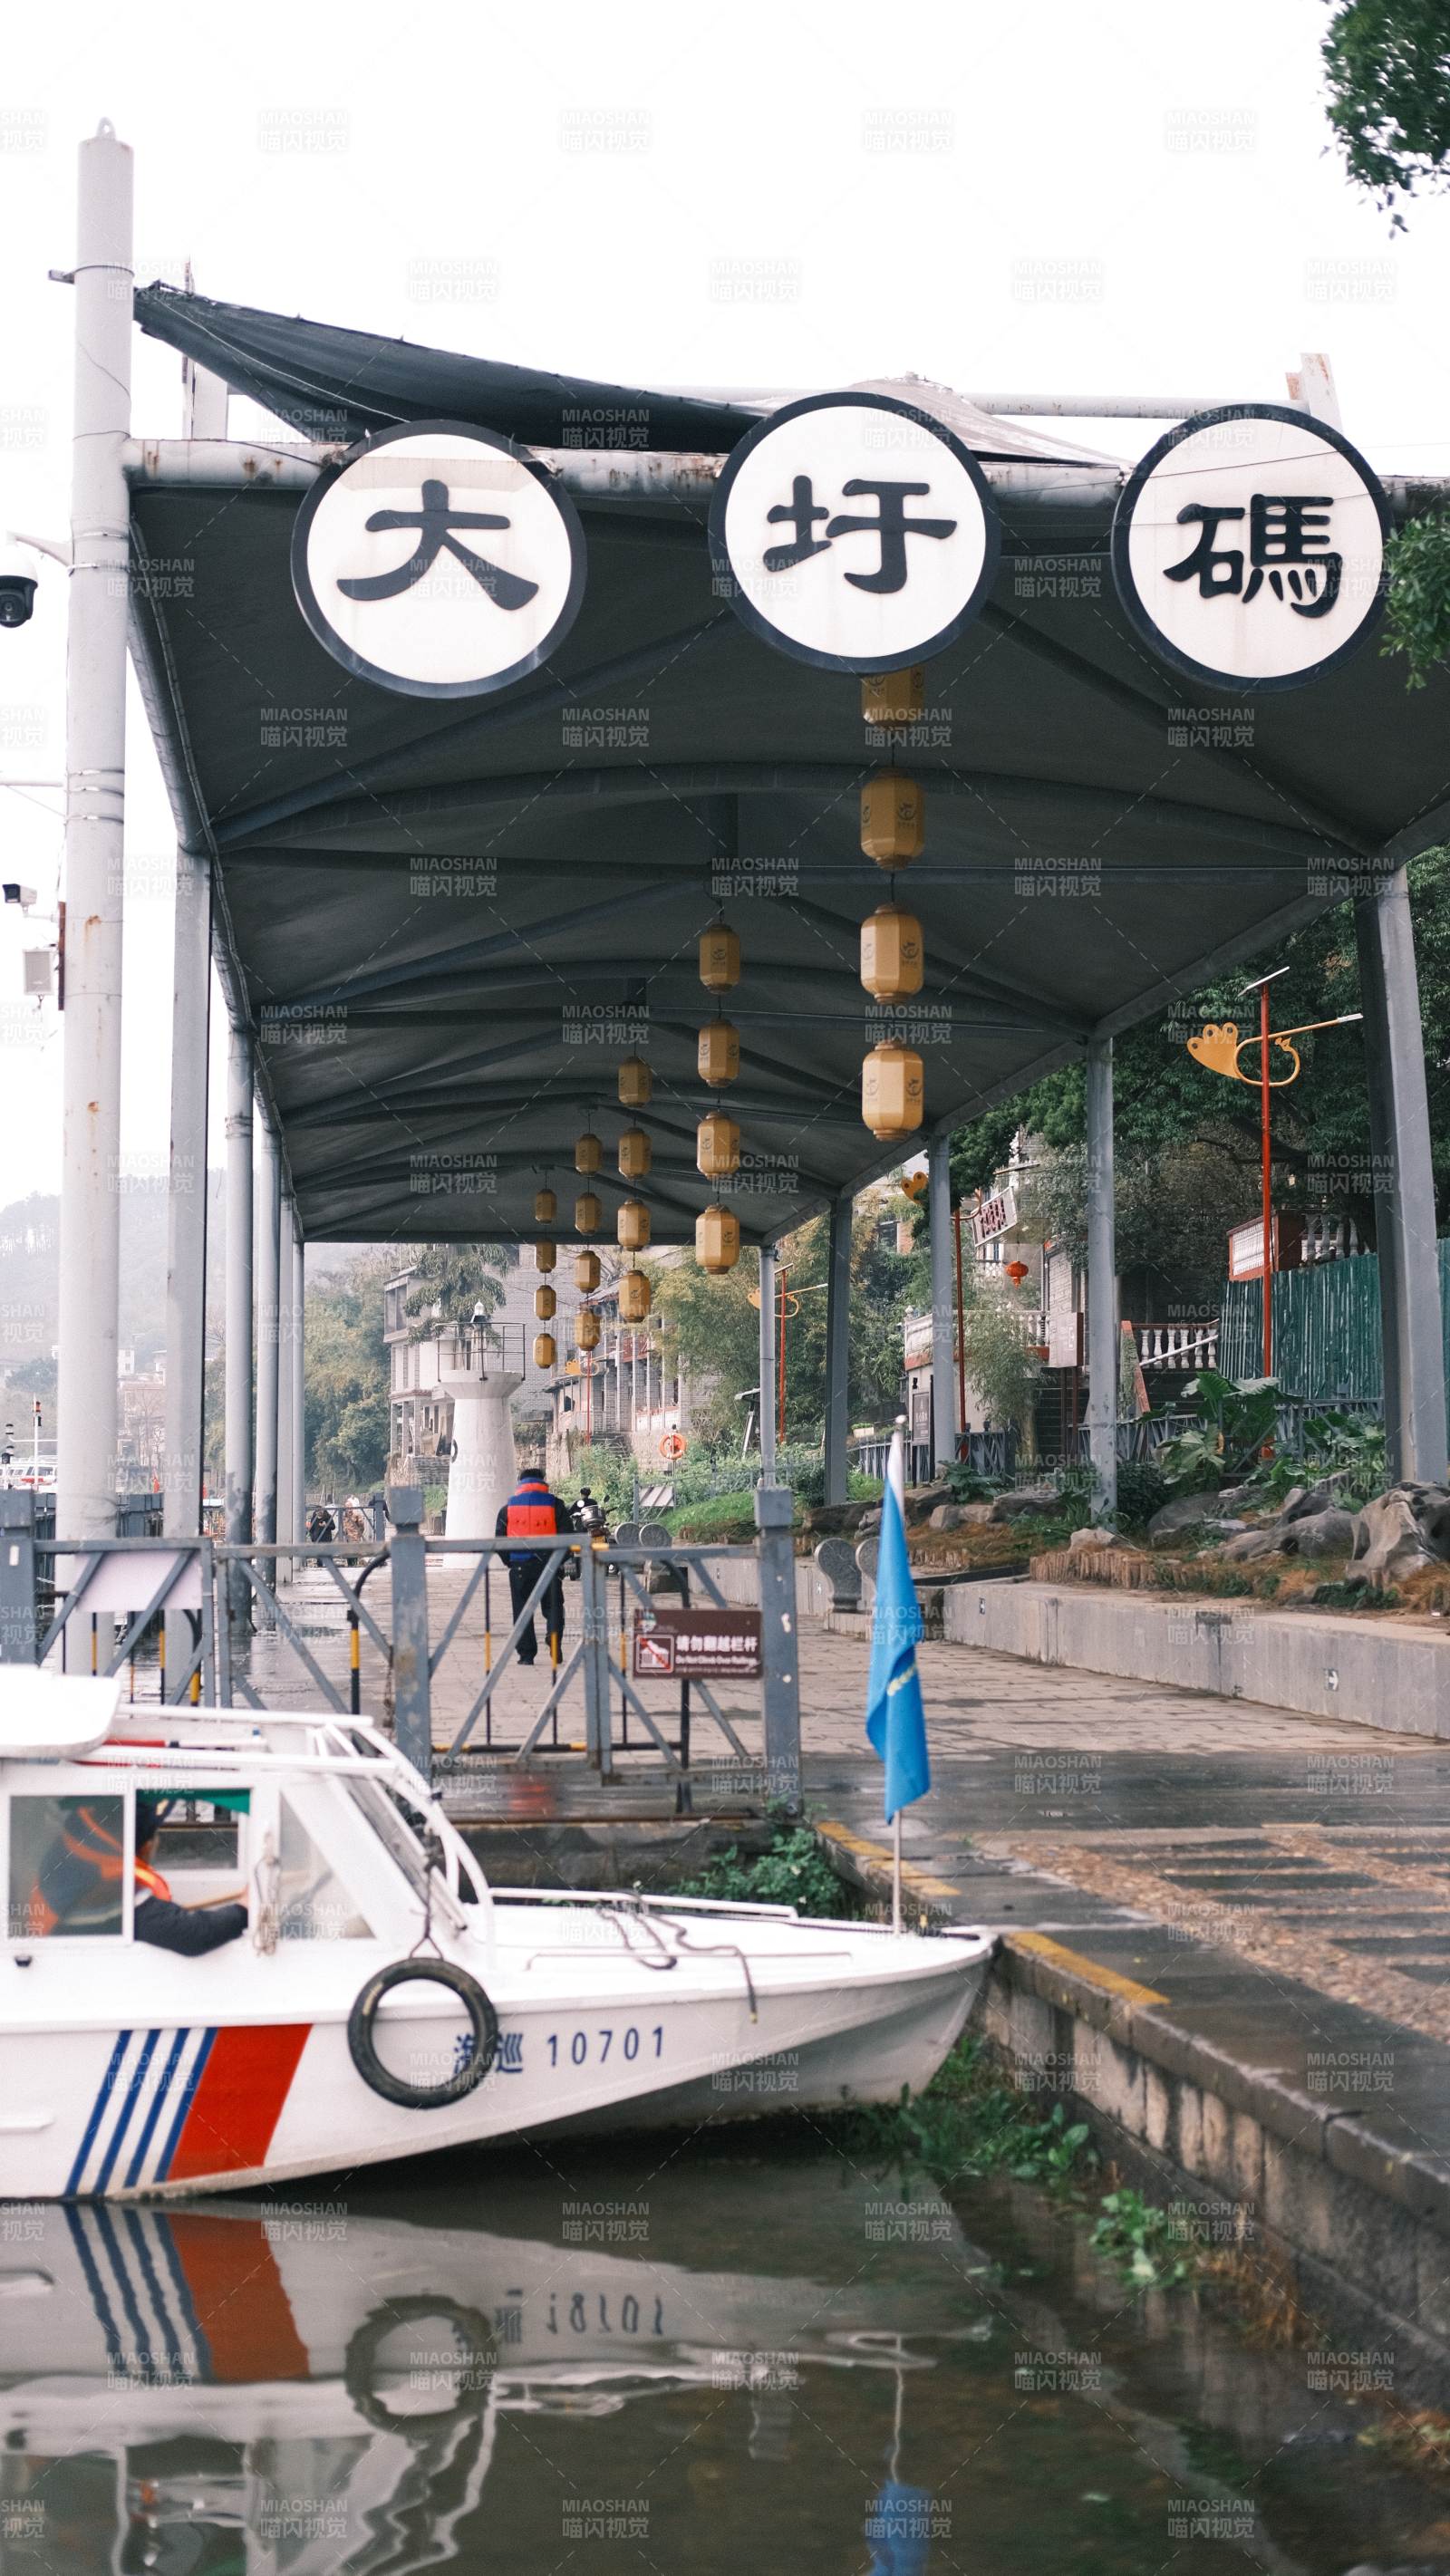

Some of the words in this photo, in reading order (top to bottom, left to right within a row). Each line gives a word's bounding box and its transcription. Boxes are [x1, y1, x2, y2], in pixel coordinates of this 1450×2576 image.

[337, 479, 539, 611] 大
[767, 475, 957, 593] 圩
[1164, 494, 1342, 619] 碼
[547, 2026, 663, 2067] 10701
